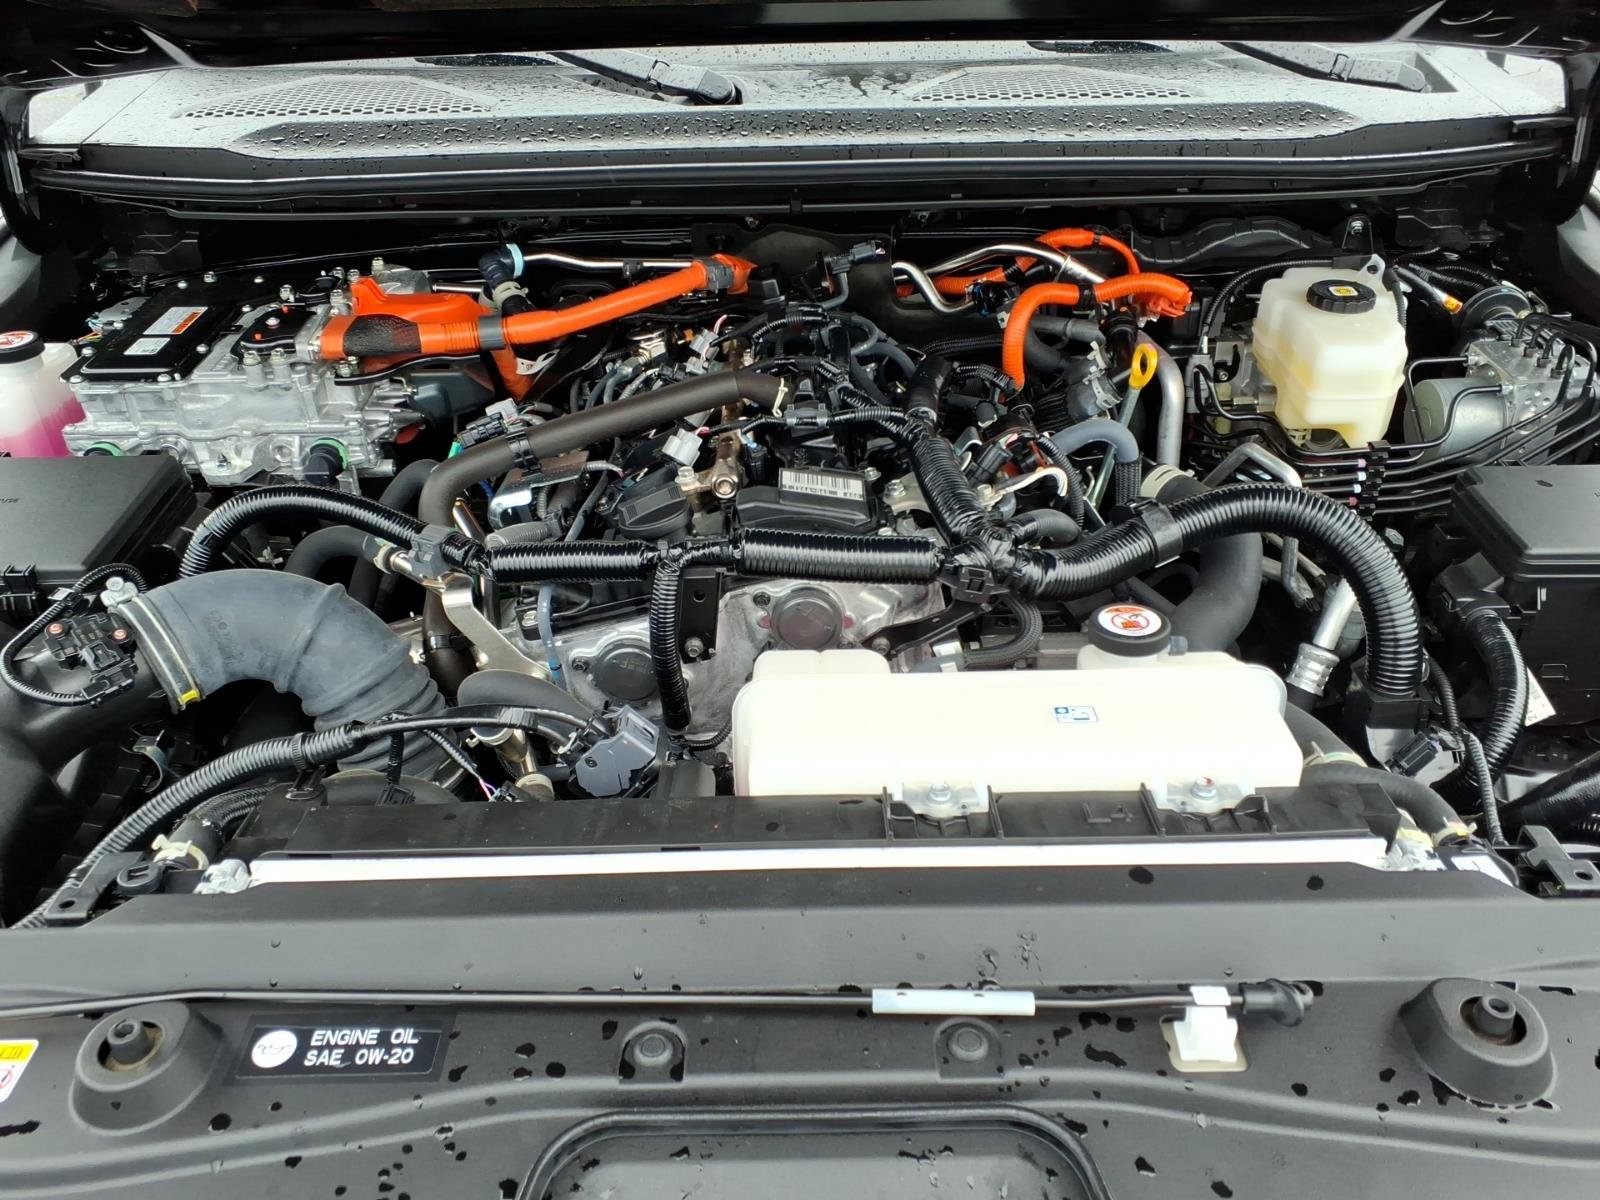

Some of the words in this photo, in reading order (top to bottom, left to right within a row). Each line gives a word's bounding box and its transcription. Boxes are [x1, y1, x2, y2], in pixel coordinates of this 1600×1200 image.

[310, 1028, 380, 1046] ENGINE
[391, 1027, 420, 1044] OIL
[303, 1048, 345, 1067] SAE
[355, 1047, 414, 1065] 0W-20
